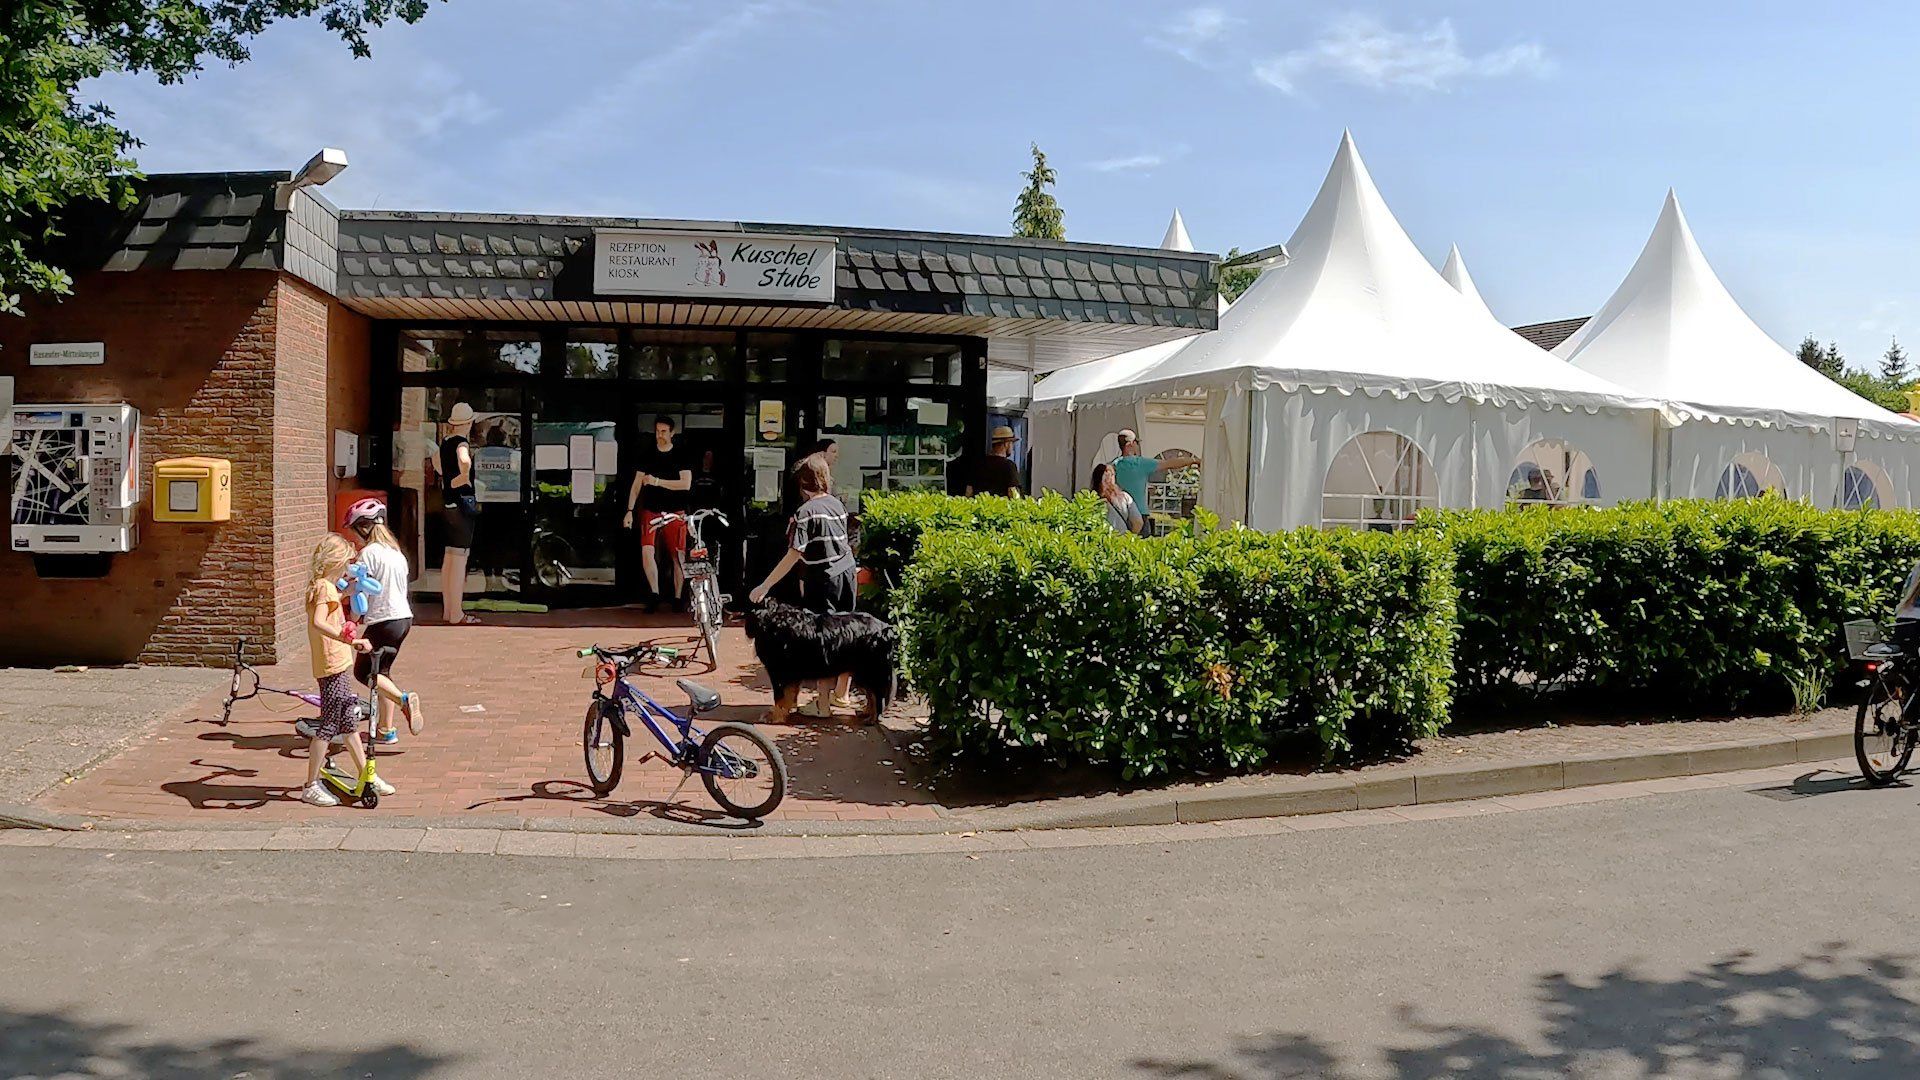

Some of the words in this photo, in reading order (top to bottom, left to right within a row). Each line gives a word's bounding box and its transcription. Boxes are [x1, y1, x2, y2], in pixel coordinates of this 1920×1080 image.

[609, 242, 666, 253] REZEPTION
[731, 242, 818, 266] Kuschel
[608, 255, 676, 267] RESTAURANT
[608, 268, 640, 279] KIOSK
[758, 267, 821, 289] Stube
